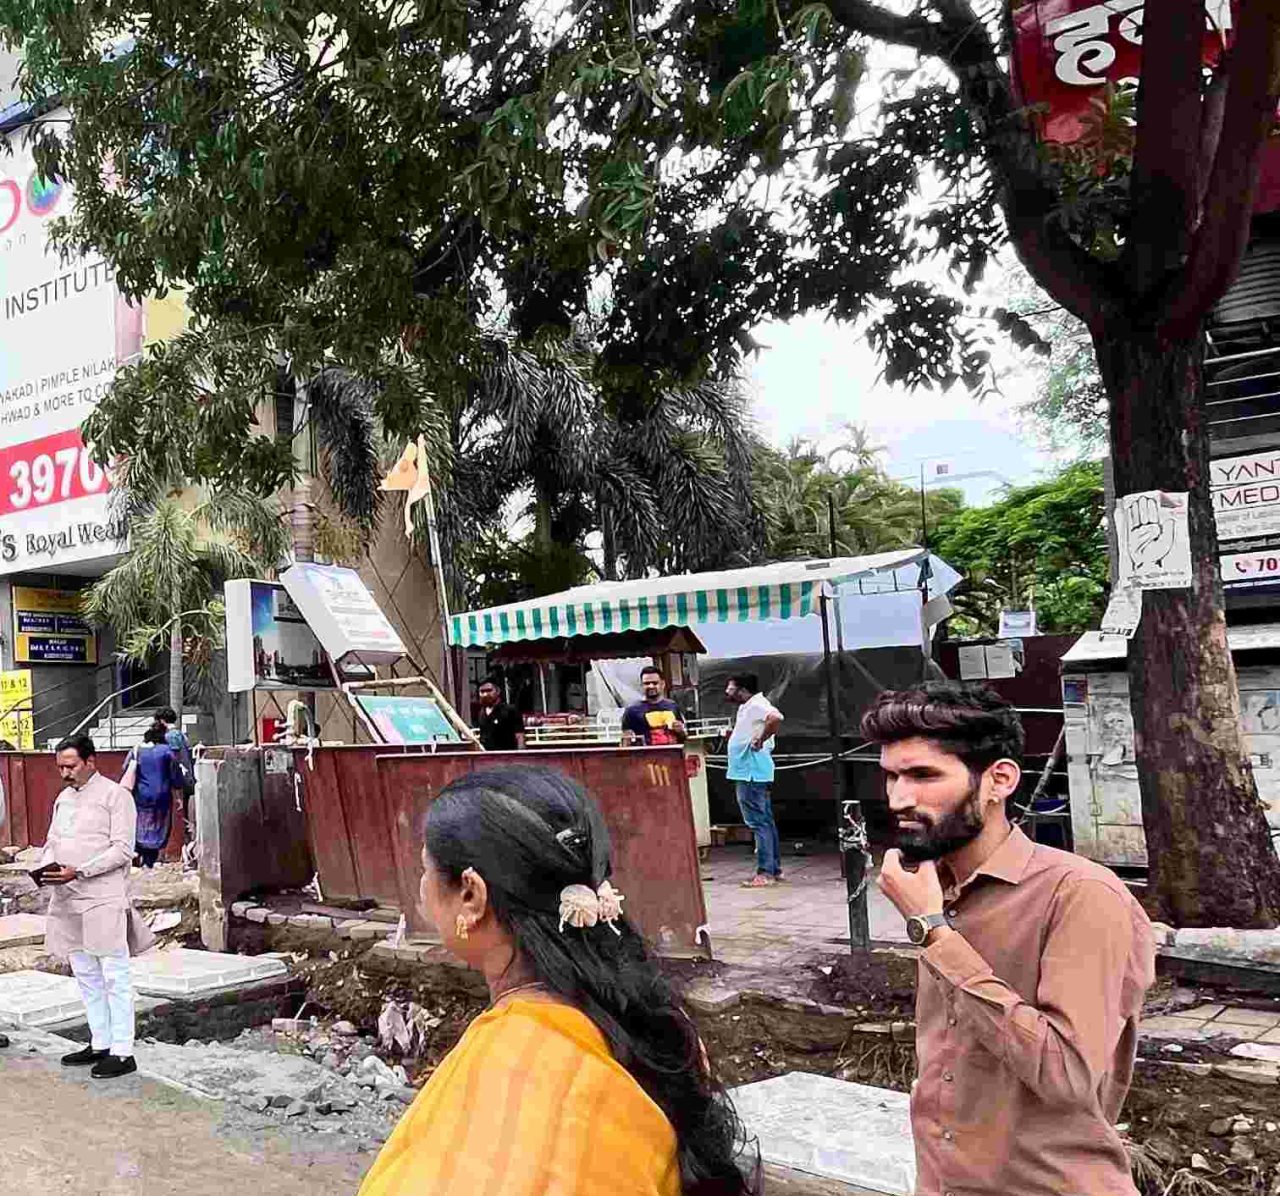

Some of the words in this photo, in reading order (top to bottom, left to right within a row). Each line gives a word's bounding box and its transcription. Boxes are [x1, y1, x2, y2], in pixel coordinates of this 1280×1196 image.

[5, 259, 115, 319] INSTITUTE
[41, 368, 80, 392] PIMPLE
[33, 402, 40, 416] &
[43, 393, 75, 412] MORE
[78, 387, 91, 404] TO
[8, 446, 112, 508] 3970
[25, 526, 77, 558] Royal
[1256, 557, 1280, 572] 70
